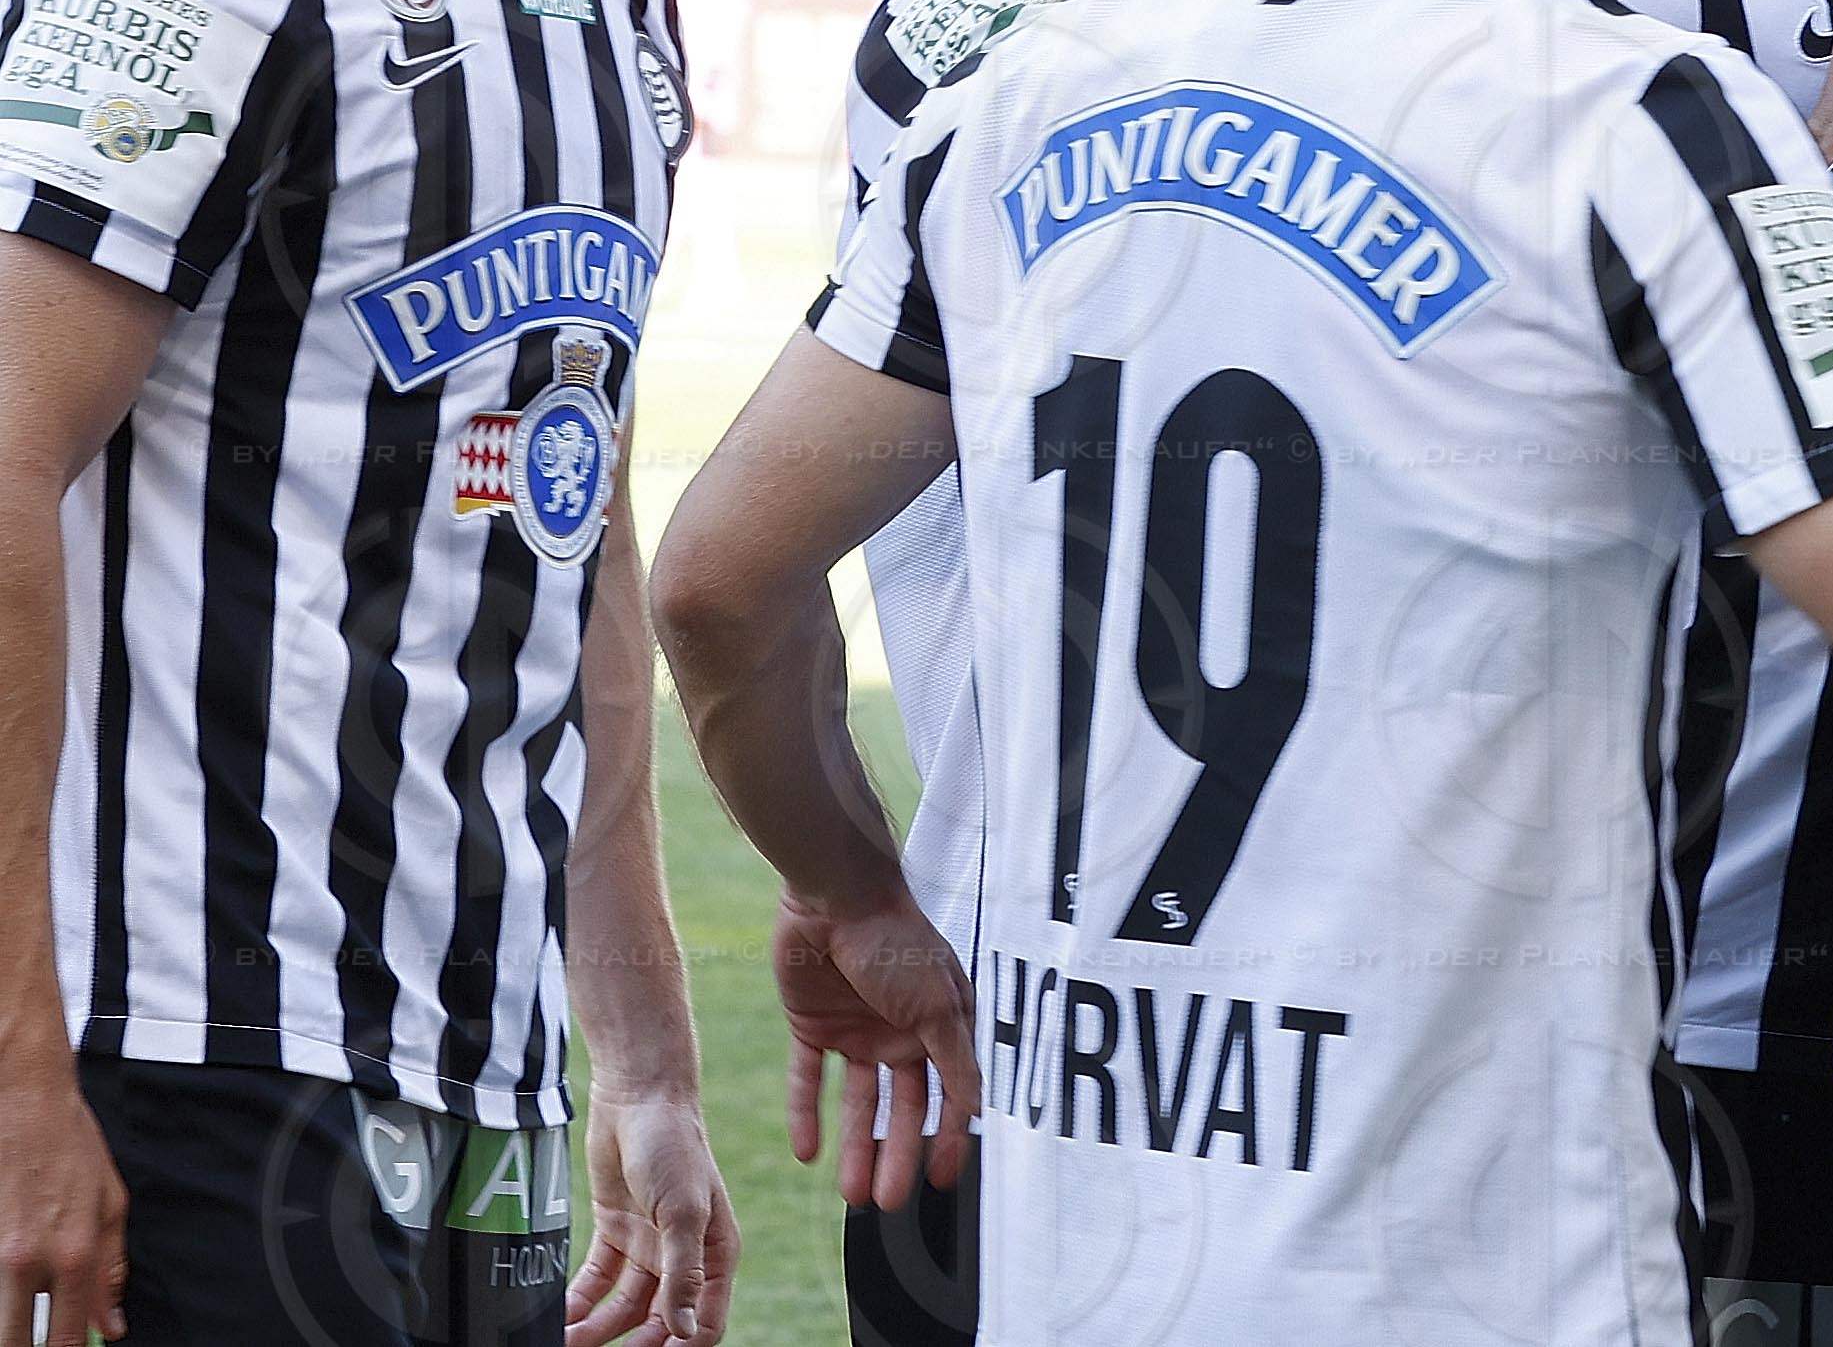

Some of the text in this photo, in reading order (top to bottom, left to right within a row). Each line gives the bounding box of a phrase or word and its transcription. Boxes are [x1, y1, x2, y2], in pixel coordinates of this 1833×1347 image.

[22, 19, 186, 96] KERNÖL
[1018, 106, 1462, 325] PUNTIGAMER
[1030, 353, 1324, 946] 19
[364, 1113, 568, 1219] GAZ
[990, 950, 1348, 1172] HORVAT
